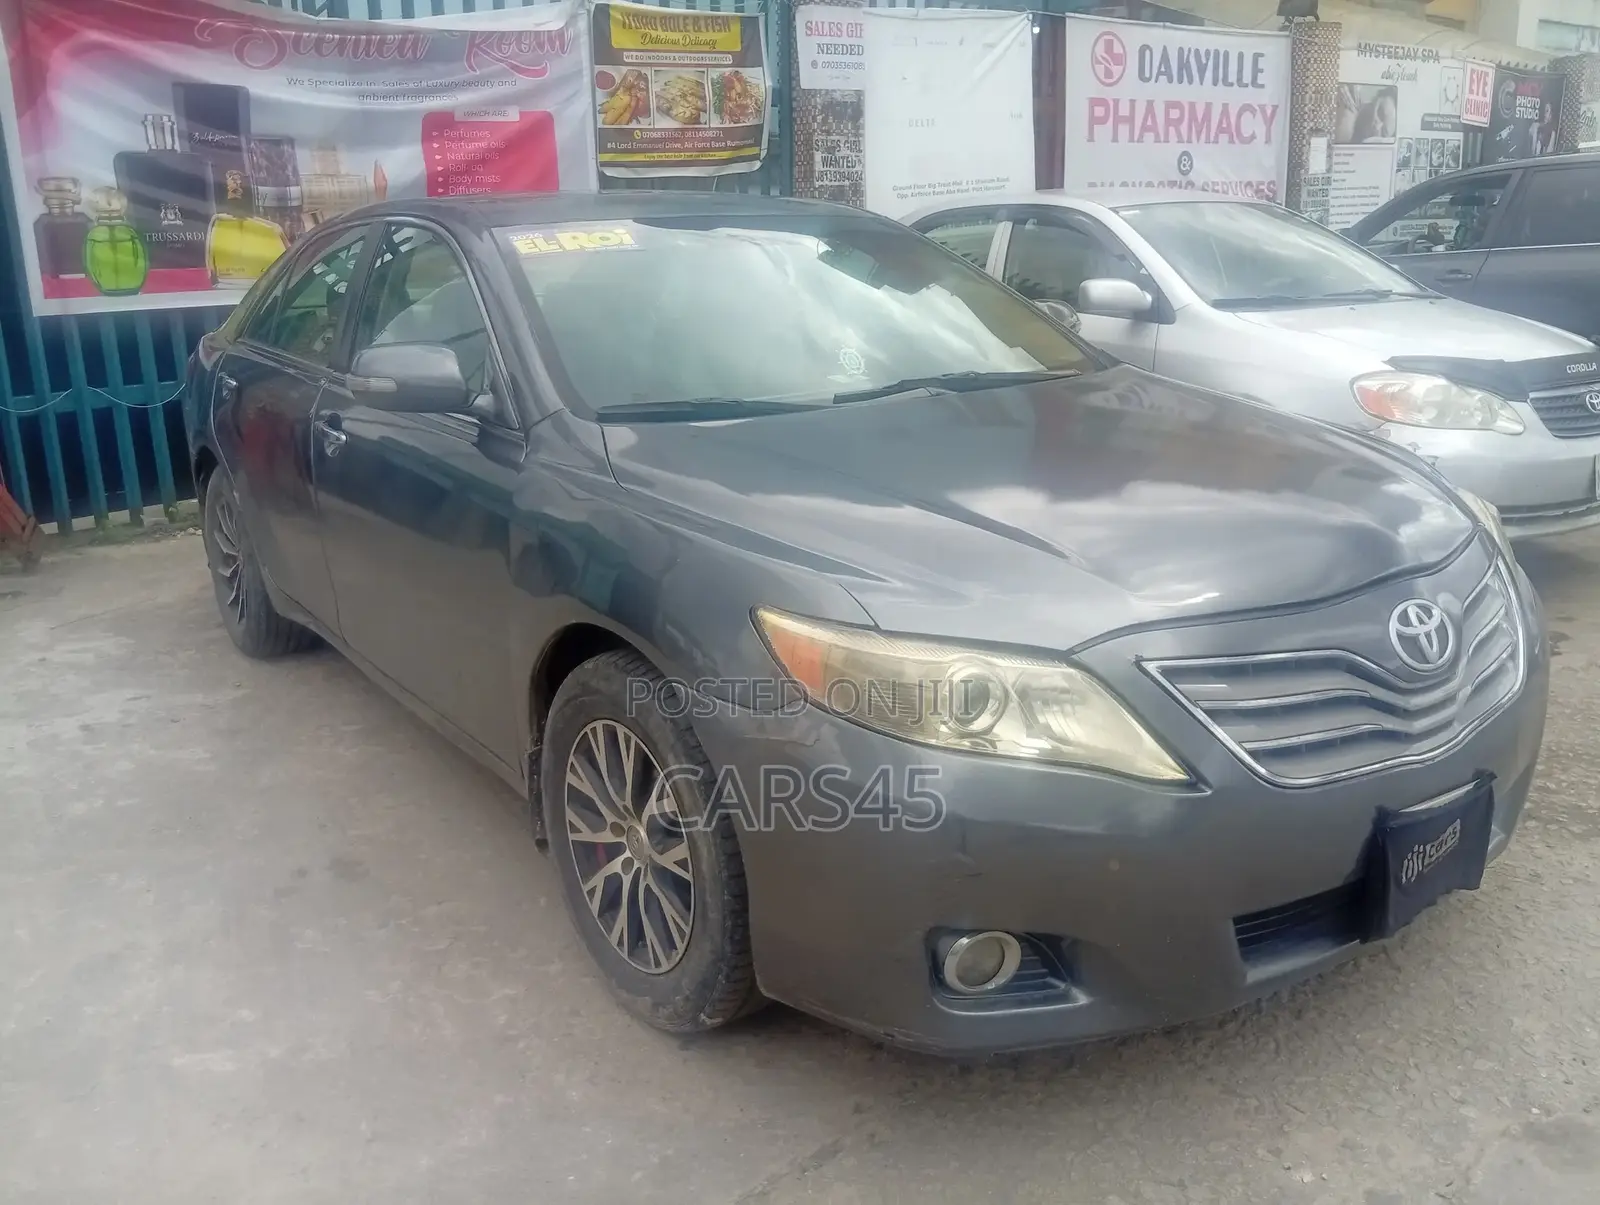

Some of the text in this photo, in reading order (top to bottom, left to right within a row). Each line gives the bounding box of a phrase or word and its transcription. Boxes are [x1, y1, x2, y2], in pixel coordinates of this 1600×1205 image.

[804, 20, 843, 37] SALES
[640, 31, 718, 50] Delicious Delicacy
[816, 43, 864, 56] NEEDED
[1357, 42, 1441, 64] MYSTEEJAY SPA
[1137, 44, 1266, 88] OAKVILLE
[286, 77, 305, 86] We
[307, 78, 363, 88] Specialize
[381, 80, 409, 88] Sales
[426, 79, 460, 89] Luxury
[461, 78, 495, 88] beauty
[497, 78, 517, 87] and
[1468, 68, 1490, 98] EYE
[1464, 99, 1489, 118] CLINIC
[1516, 95, 1541, 109] PHOTO
[463, 109, 491, 117] WHICH
[1515, 106, 1540, 120] STUDIO
[1086, 97, 1279, 145] PHARMACY
[443, 129, 491, 138] Perfumes
[444, 140, 506, 149] Perfume oils
[617, 141, 632, 149] Lord
[665, 141, 684, 150] Drive,
[711, 140, 726, 148] Base
[814, 138, 842, 153] SALES
[446, 152, 500, 160] Natural oils
[821, 155, 857, 169] WANTED
[1179, 155, 1192, 171] &
[448, 175, 501, 184] Body mists
[448, 186, 492, 196] Diffusers
[144, 231, 205, 242] TRUSSARDI
[509, 233, 543, 241] 2026
[513, 236, 564, 255] EL
[1566, 362, 1598, 373] COROLLA
[1427, 825, 1459, 859] cars
